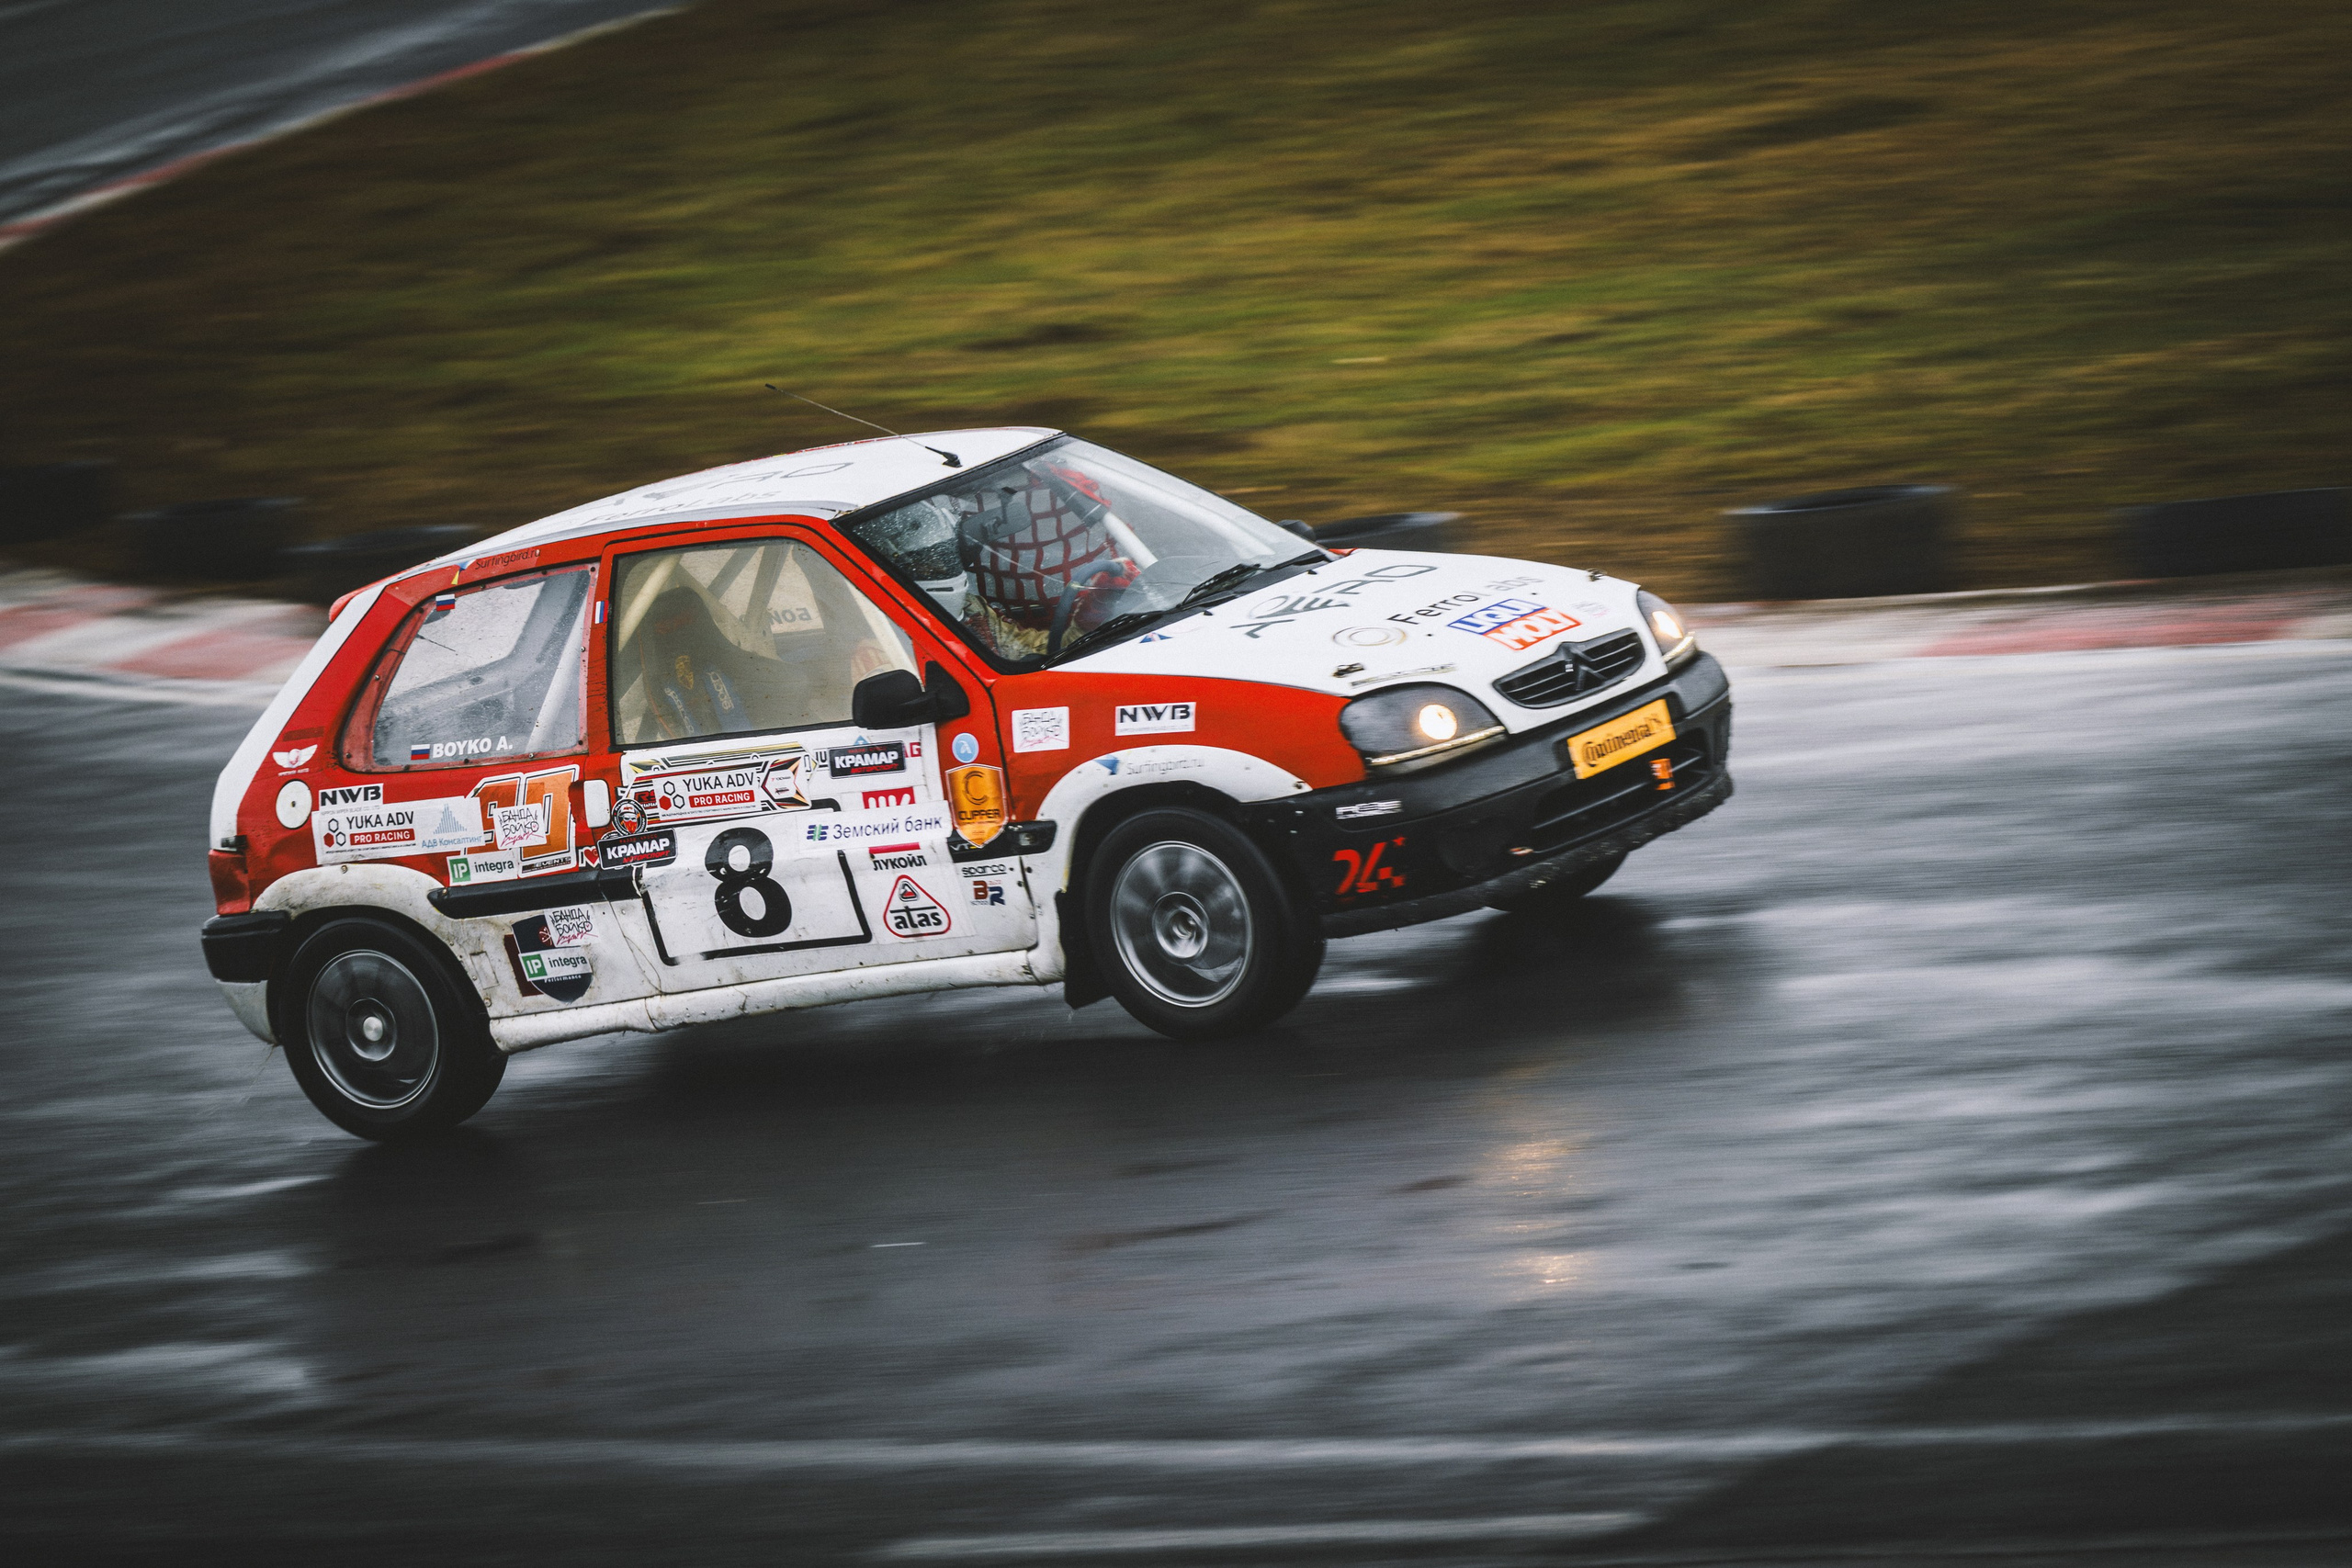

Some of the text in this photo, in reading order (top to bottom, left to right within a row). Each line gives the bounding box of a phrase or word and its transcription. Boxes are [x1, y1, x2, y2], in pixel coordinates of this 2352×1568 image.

[474, 549, 541, 570] Surfingbird.ru
[1450, 600, 1544, 634] LIQUI
[1487, 610, 1577, 649] MOLY
[1119, 705, 1190, 723] NWB
[432, 736, 513, 759] BOYKO A.
[834, 751, 899, 769] КРАМАР
[683, 773, 754, 793] YUKA ADV
[321, 785, 381, 807] NWB
[694, 793, 751, 807] PRO RACING
[346, 811, 414, 829] YUKA ADV
[832, 816, 943, 840] Земский банк
[354, 830, 411, 843] PRO RACING
[421, 839, 437, 849] АДВ
[438, 835, 482, 847] Консалтинг
[606, 838, 671, 860] КРАМАР
[452, 862, 469, 879] IP
[474, 858, 514, 875] integra
[873, 854, 928, 871] ЛУКОЙЛ
[961, 863, 1007, 877] sparco
[705, 827, 792, 938] 8
[890, 906, 943, 930] atas
[526, 956, 588, 975] IP integra
